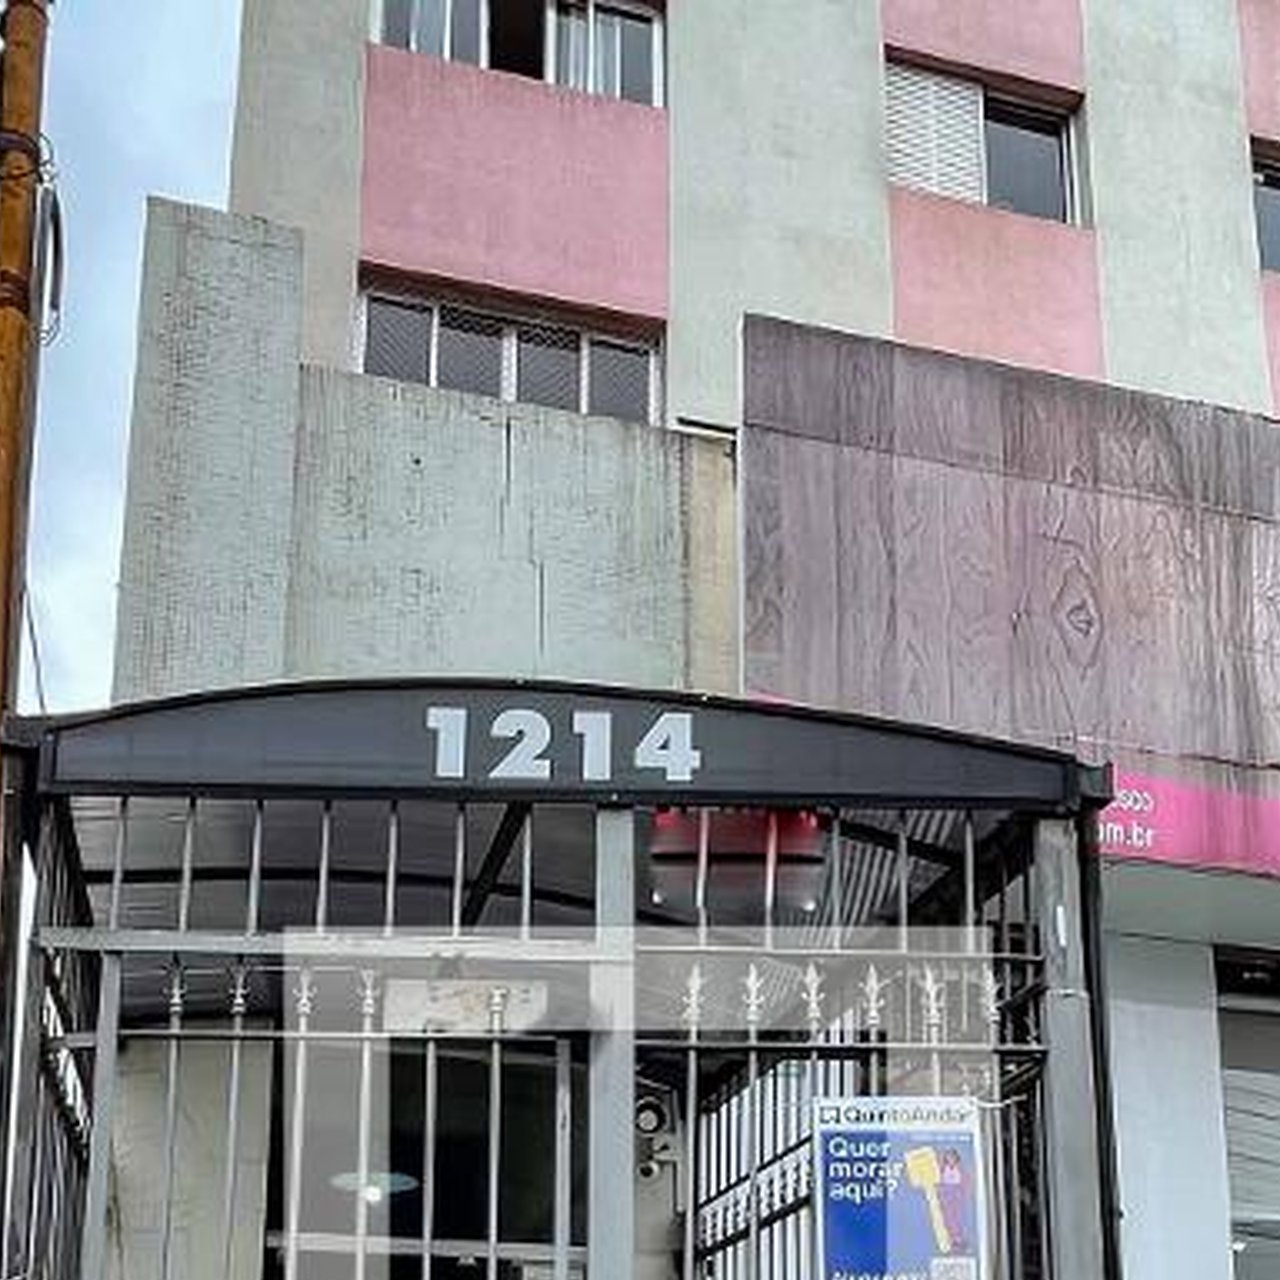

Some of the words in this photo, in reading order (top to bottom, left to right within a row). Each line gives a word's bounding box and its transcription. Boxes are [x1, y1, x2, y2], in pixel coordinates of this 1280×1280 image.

[425, 706, 702, 782] 1214
[829, 1136, 892, 1158] Quer
[828, 1160, 904, 1179] morar
[829, 1179, 899, 1206] aqui?
